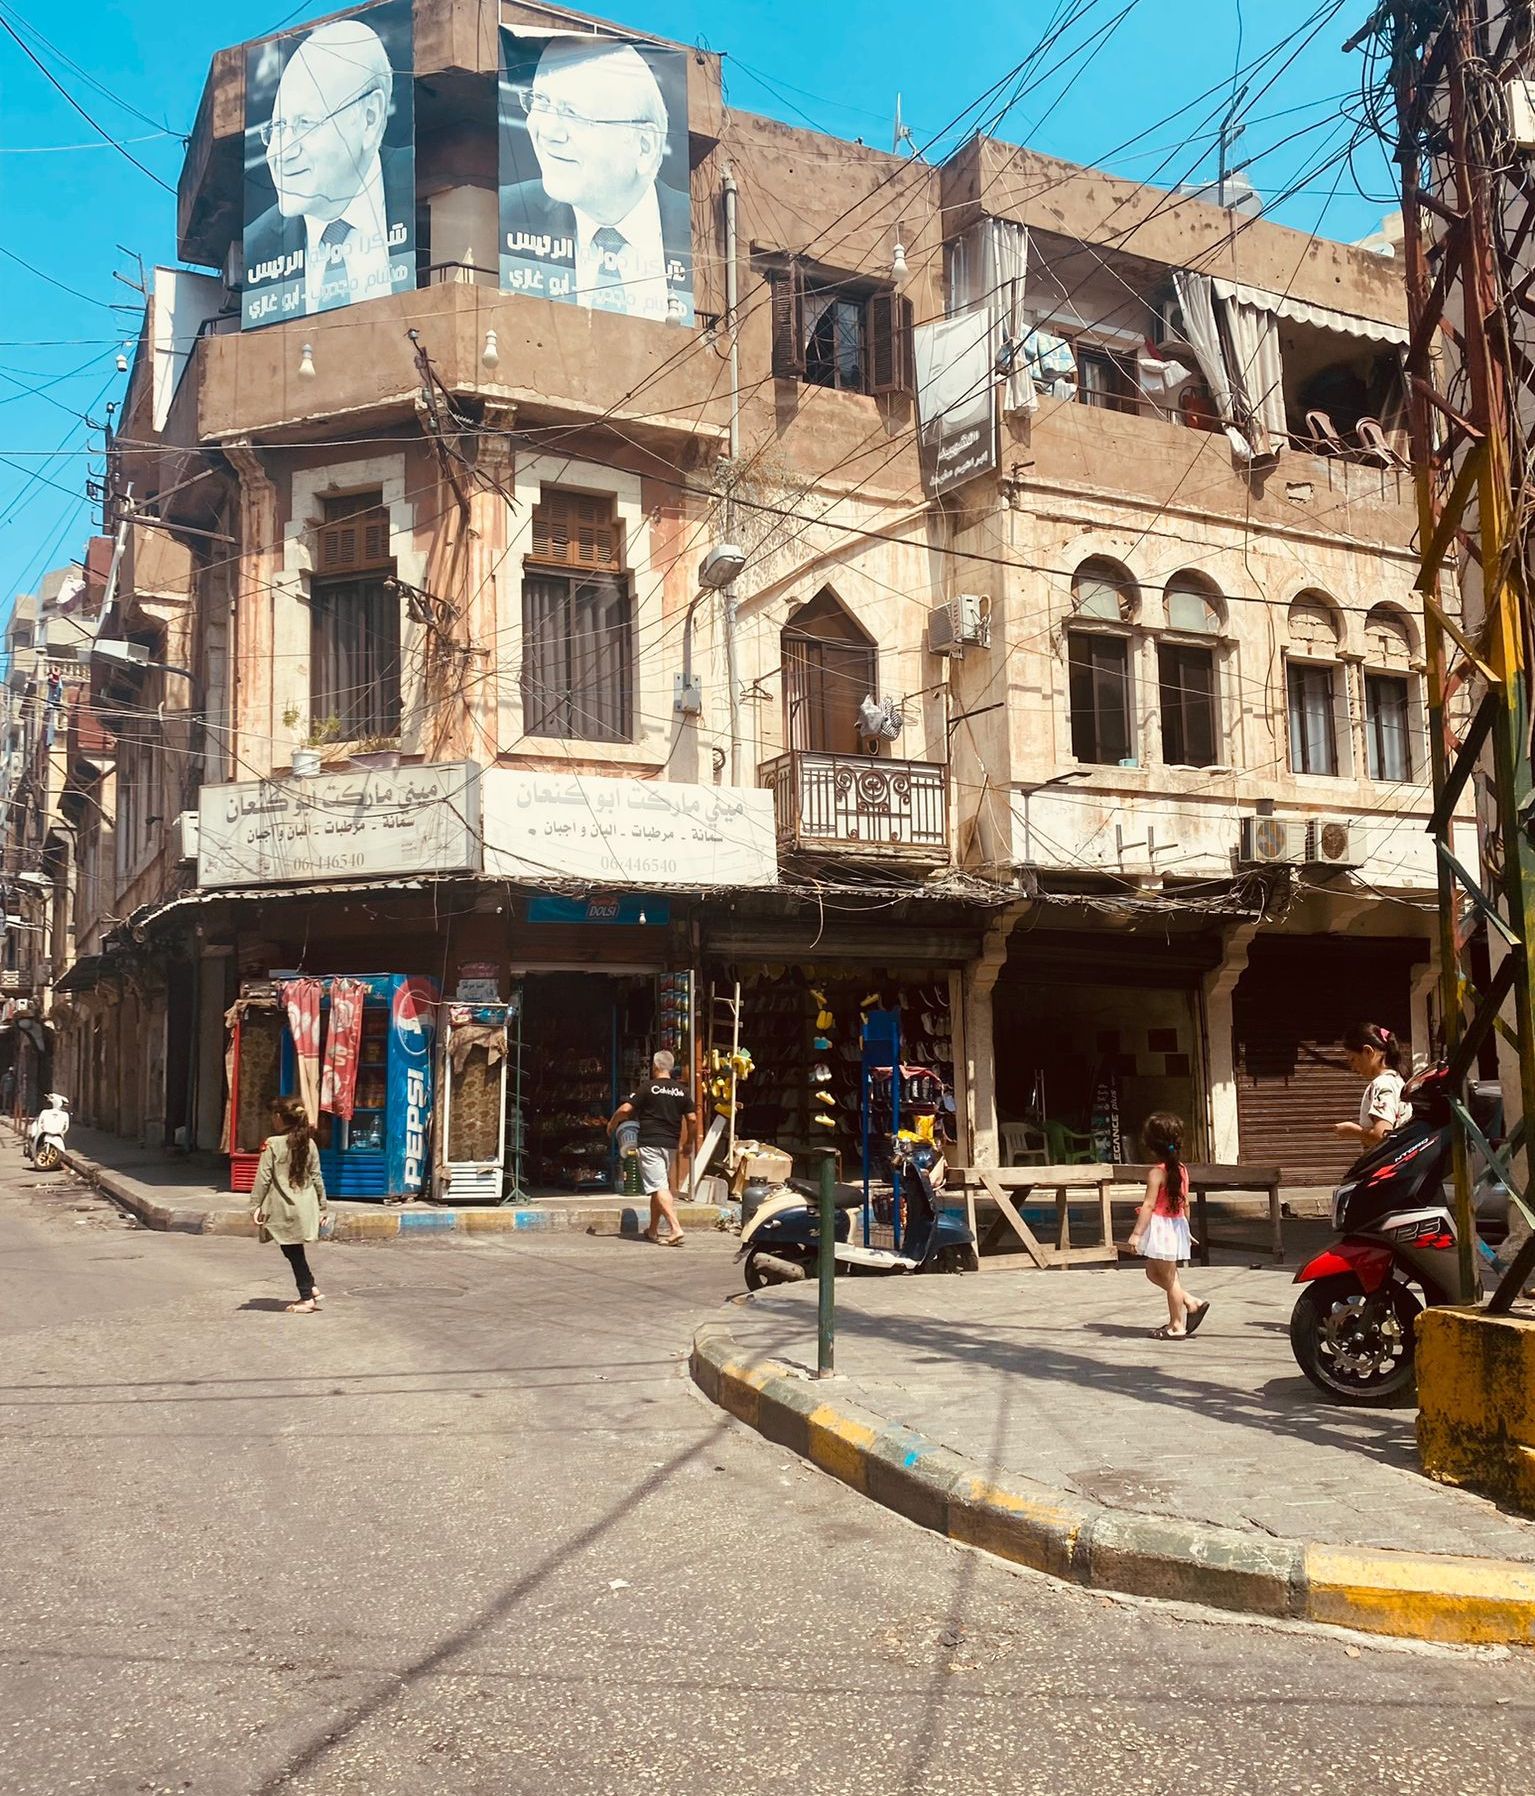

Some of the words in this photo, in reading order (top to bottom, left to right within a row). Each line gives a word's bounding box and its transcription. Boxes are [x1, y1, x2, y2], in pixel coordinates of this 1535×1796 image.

[507, 231, 573, 259] الرئيس
[247, 249, 304, 284] الرئيس
[226, 788, 290, 824] كنعان
[323, 782, 393, 812] ماركت
[516, 782, 588, 808] كنعان
[597, 788, 621, 814] ابو
[628, 786, 701, 817] ماركت
[382, 815, 415, 830] سمانة
[705, 796, 744, 829] ميني
[325, 820, 366, 836] مرطبات
[544, 821, 577, 837] اجبان
[580, 828, 586, 838] و
[631, 824, 675, 841] مرطبات
[691, 827, 724, 842] سمانة
[588, 905, 617, 917] DOLSI
[404, 1067, 426, 1186] PEPSI
